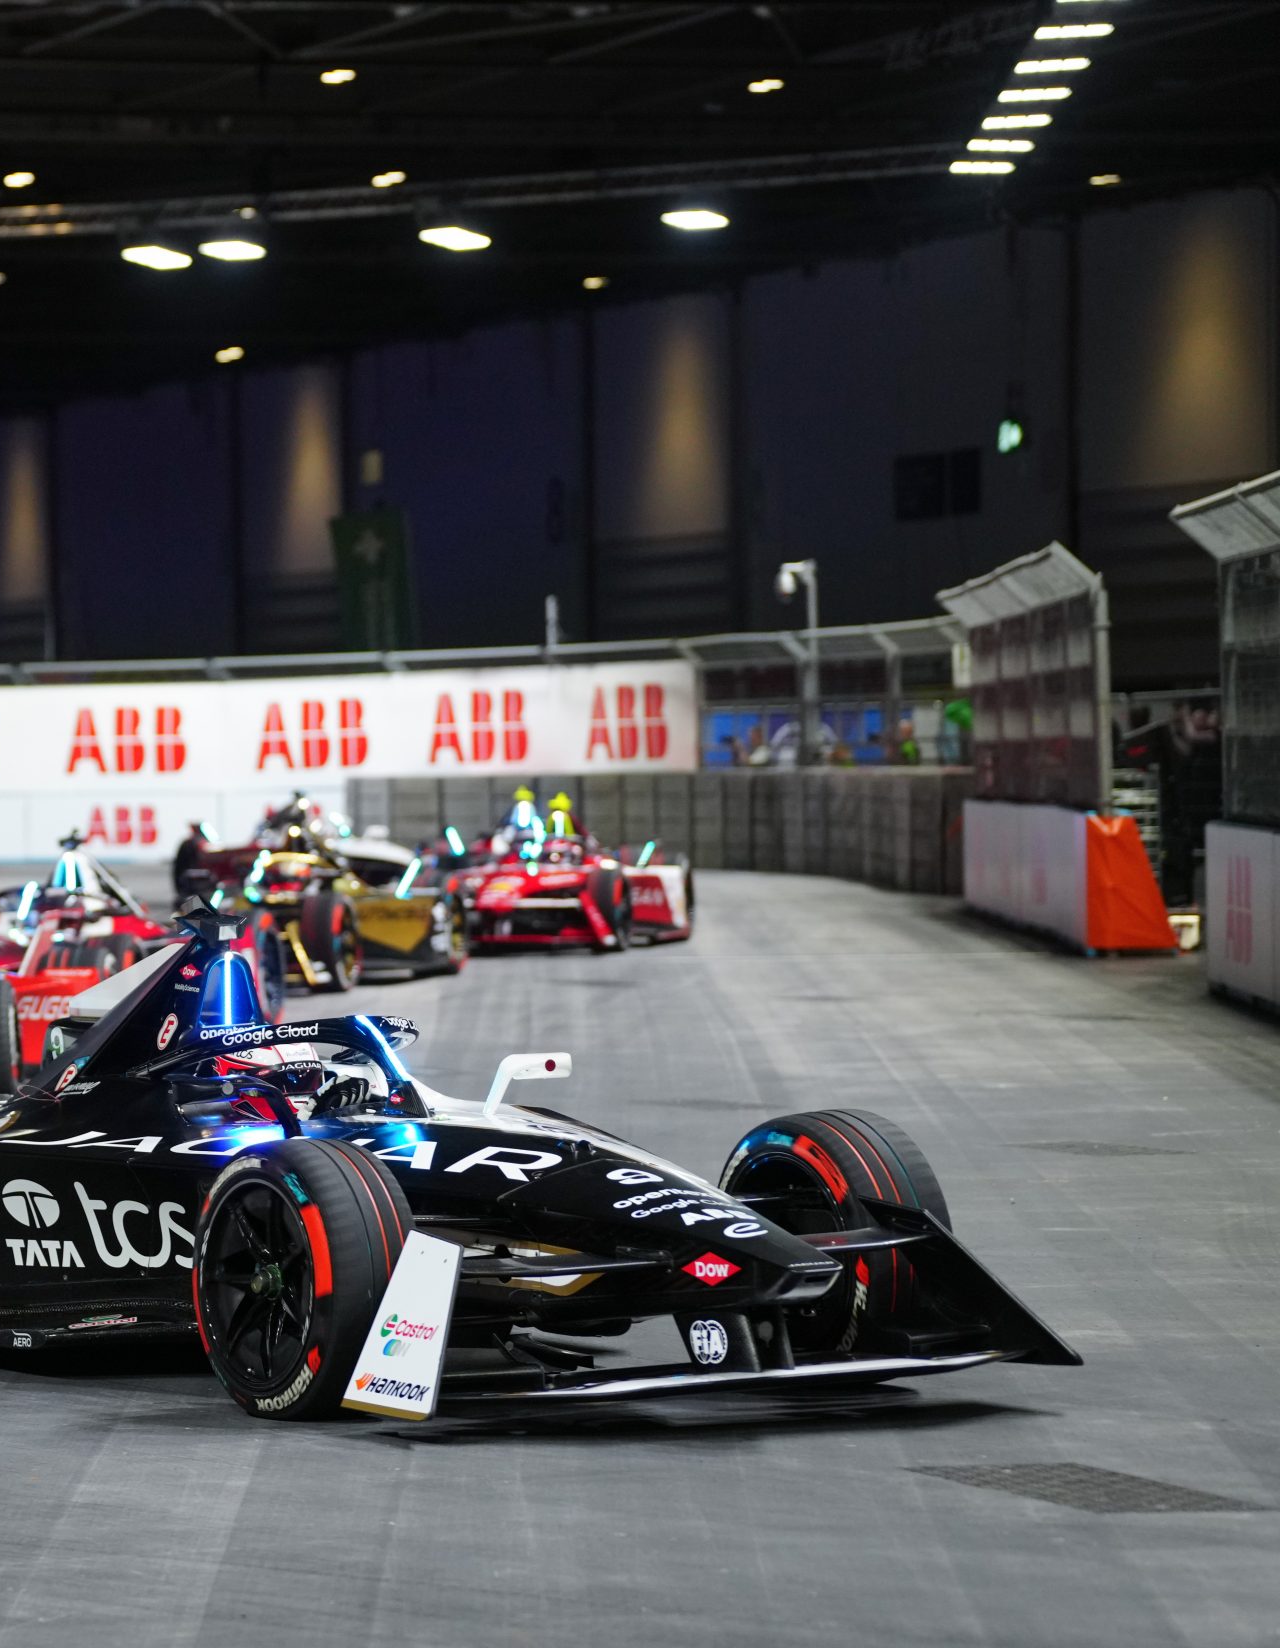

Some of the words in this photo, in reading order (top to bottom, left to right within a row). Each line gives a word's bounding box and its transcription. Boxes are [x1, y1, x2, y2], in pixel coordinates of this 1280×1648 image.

[67, 706, 187, 774] ABB
[257, 698, 369, 770] ABB
[430, 690, 529, 764] ABB
[587, 683, 668, 760] ABB
[84, 805, 157, 844] ABB
[222, 1028, 273, 1046] Google
[276, 1023, 318, 1039] Cloud
[74, 1181, 195, 1268] tcs
[5, 1238, 86, 1268] TATA
[13, 1337, 32, 1348] AERO
[395, 1319, 439, 1341] Castrol
